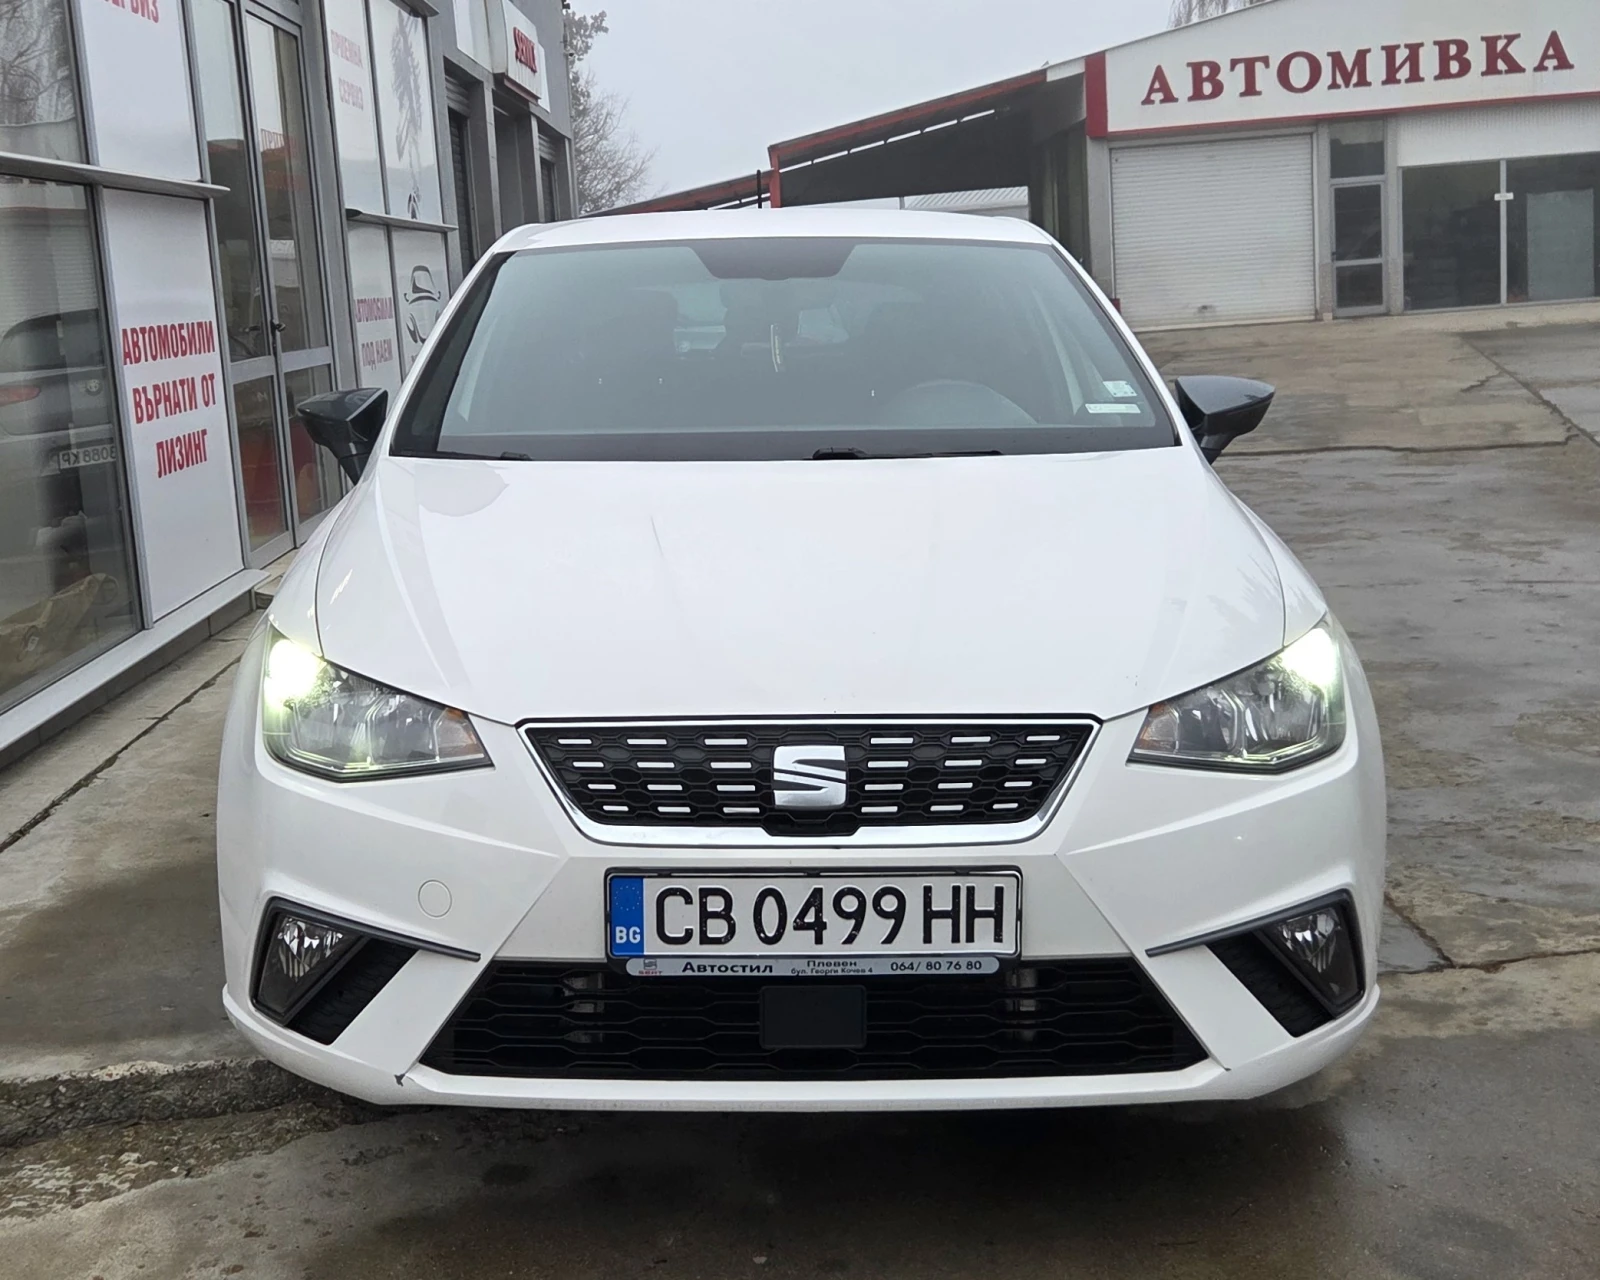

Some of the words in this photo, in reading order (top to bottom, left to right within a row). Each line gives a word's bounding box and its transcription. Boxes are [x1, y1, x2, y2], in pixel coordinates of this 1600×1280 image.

[1141, 30, 1574, 105] АВТОМИВКА
[122, 320, 215, 366] АВТОМОБИЛИ
[132, 377, 198, 424] ВЪРНАТИ
[200, 373, 216, 407] ОТ
[156, 428, 208, 478] ЛИЗИНГ
[615, 926, 641, 944] BG
[753, 886, 907, 945] 0499
[682, 961, 773, 974] Автостил
[810, 967, 839, 976] Георги
[890, 961, 921, 971] 064/
[925, 960, 942, 970] 80
[946, 960, 961, 970] 76
[965, 960, 982, 970] 80
